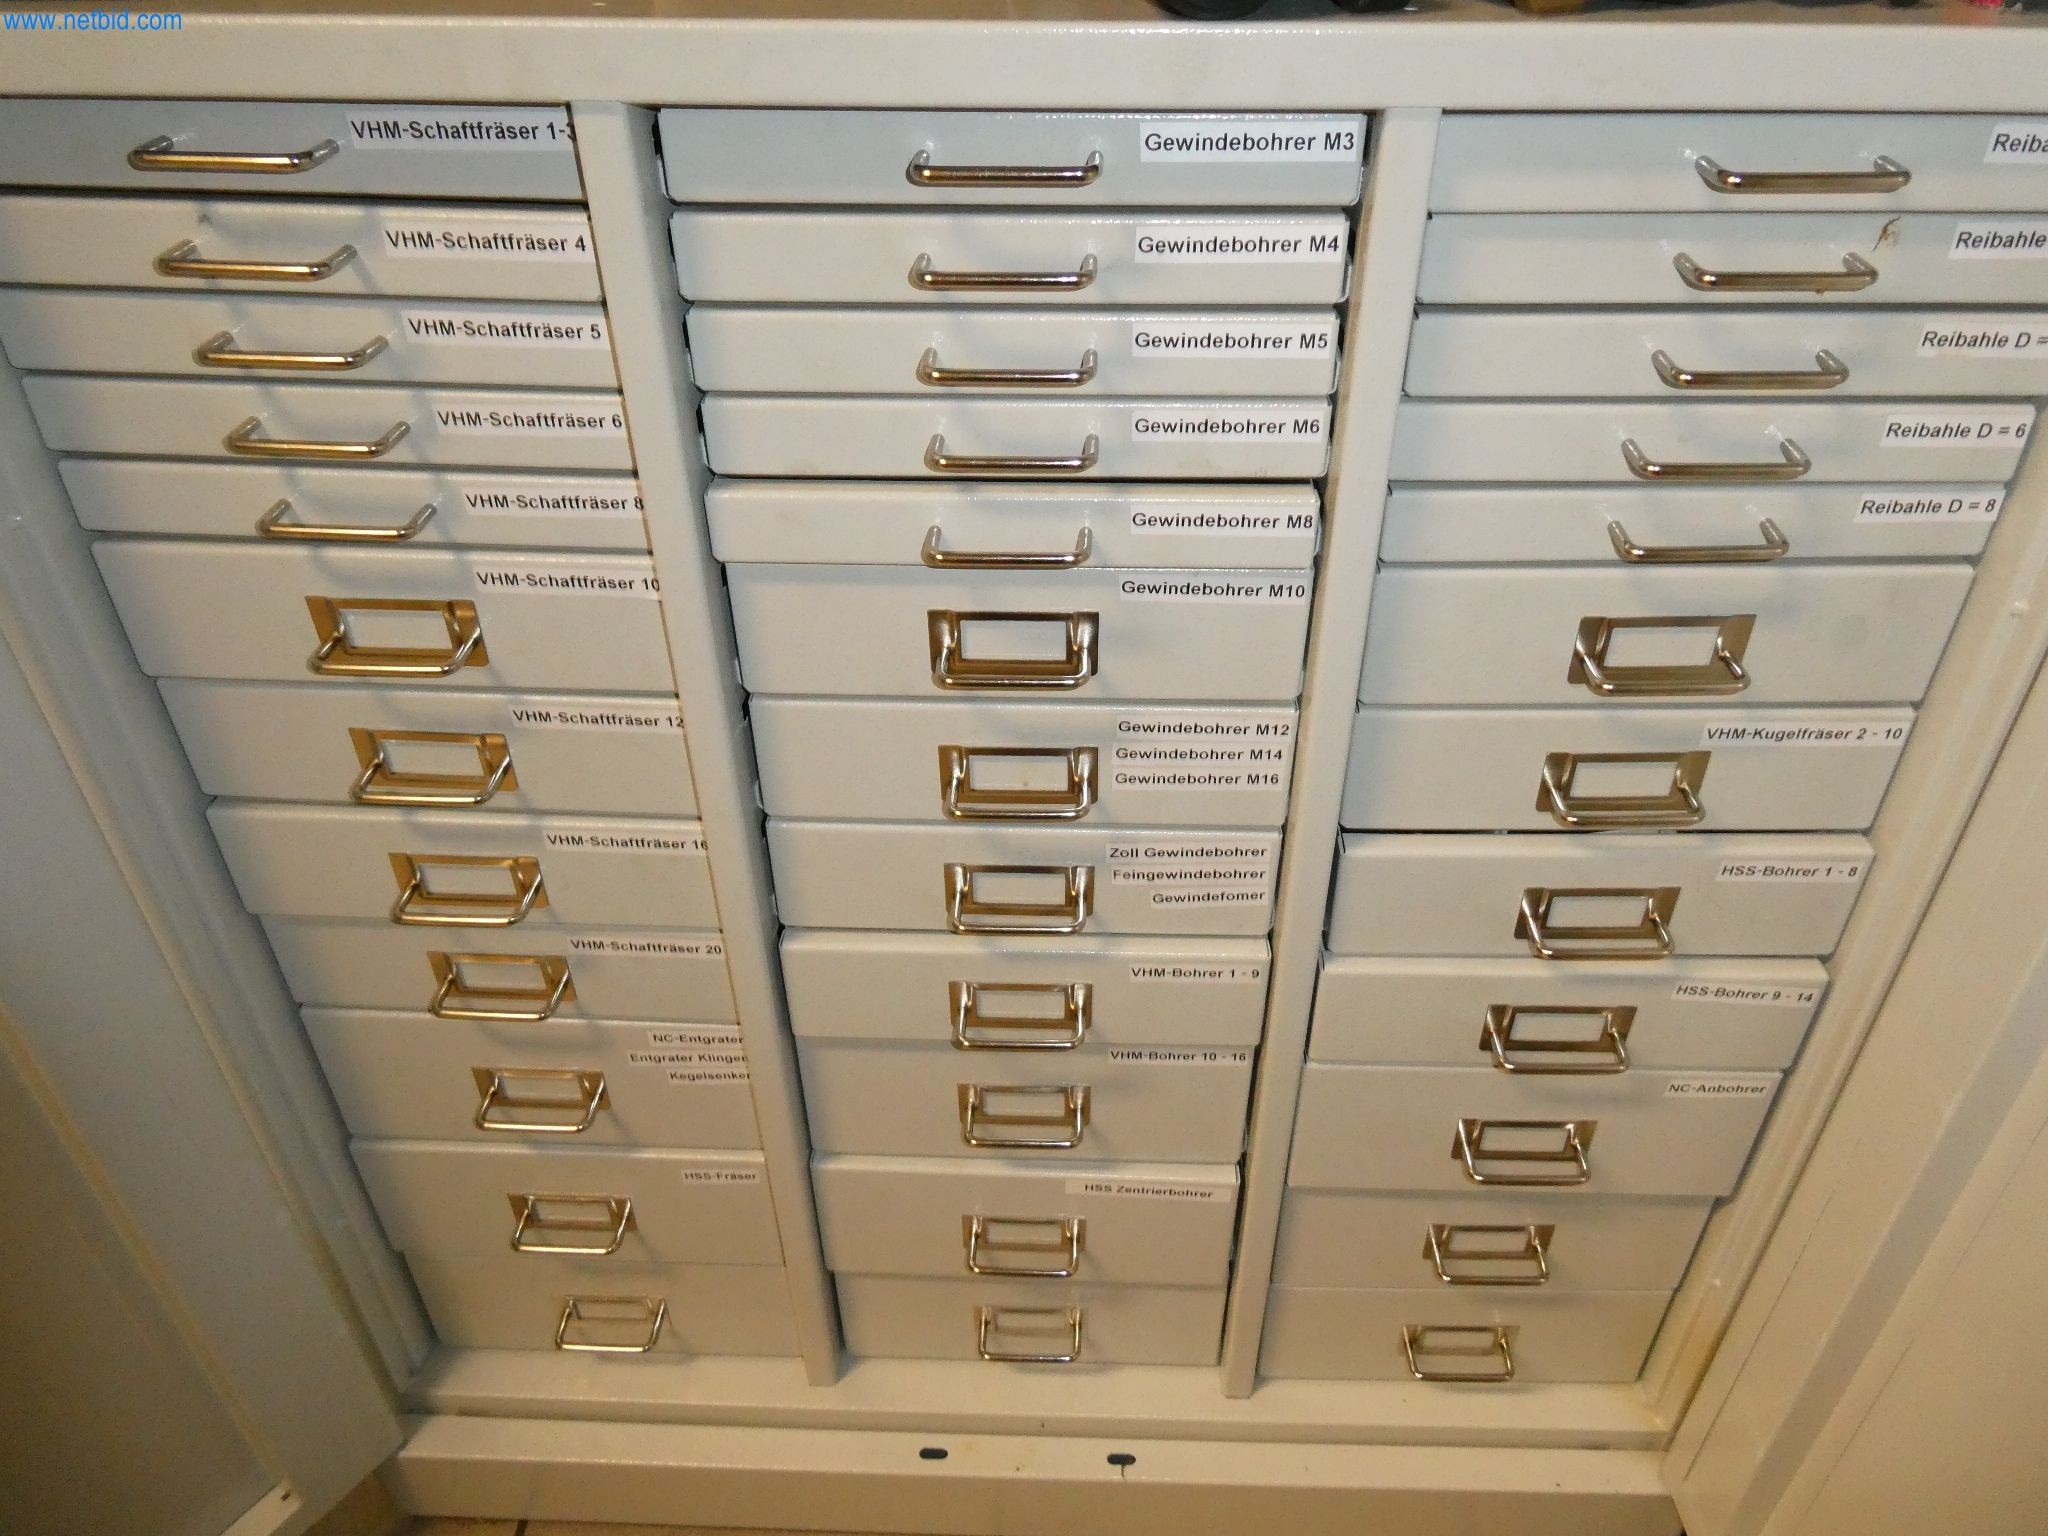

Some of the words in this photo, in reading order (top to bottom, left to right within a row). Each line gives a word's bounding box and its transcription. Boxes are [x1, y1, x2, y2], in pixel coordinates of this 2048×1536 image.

[351, 120, 539, 140] VHM-Schaftfräser
[1145, 133, 1316, 151] Gewindebohrer
[1324, 132, 1355, 151] M3
[386, 230, 568, 251] VHM-Schaftfräser
[575, 235, 586, 251] 4
[1138, 236, 1302, 253] Gewindebohrer
[1309, 235, 1340, 252] M4
[1955, 231, 2047, 249] Reibahle
[408, 318, 584, 339] VHM-Schaftfräser
[591, 323, 601, 339] 5
[1134, 332, 1293, 349] Gewindebohrer
[1299, 333, 1329, 349] M5
[1921, 331, 2009, 348] Reibahle
[2014, 332, 2031, 348] D
[437, 411, 606, 428] VHM-Schaftfräser
[611, 414, 622, 428] 6
[1134, 418, 1287, 434] Gewindebohrer
[1293, 419, 1320, 434] M6
[1885, 422, 1971, 438] Reibahle
[1976, 423, 1993, 438] D
[2015, 423, 2027, 438] 6
[465, 493, 628, 511] VHM-Schaftfräser
[633, 496, 645, 511] 8
[1860, 500, 1942, 514] Reibahle
[1947, 499, 1963, 513] D
[1985, 499, 1997, 513] 8
[1132, 512, 1280, 529] Gewindebohrer
[1286, 514, 1313, 529] M8
[477, 571, 635, 590] VHM-Schaftfräser
[641, 577, 660, 592] 10
[1121, 580, 1263, 597] Gewindebohrer
[1268, 584, 1305, 598] M10
[512, 710, 660, 727] VHM-Schaftfräser
[665, 715, 684, 728] 12
[1118, 720, 1251, 735] Gewindebohrer
[1256, 723, 1290, 736] M12
[1706, 727, 1852, 742] VHM-Kugelfräser
[1856, 728, 1867, 740] 2
[1884, 728, 1903, 739] 10
[1115, 747, 1245, 761] Gewindebohrer
[1249, 749, 1283, 760] M14
[1115, 772, 1242, 785] Gewindebohrer
[1246, 773, 1279, 785] M16
[547, 834, 686, 849] VHM-Schaftfräser
[692, 840, 708, 850] 16
[1109, 848, 1139, 858] Zoll
[1144, 848, 1268, 858] Gewindebohrer
[1113, 869, 1267, 882] Feingewindebohrer
[1721, 865, 1819, 877] HSS-Bohrer
[1825, 866, 1832, 876] 1
[1847, 866, 1859, 876] 8
[1152, 890, 1266, 904] Gewindefomer
[571, 939, 700, 955] VHM-Schaftfräser
[705, 945, 722, 954] 20
[1131, 967, 1224, 978] VHM-Bohrer
[1229, 969, 1236, 978] 1
[1251, 969, 1260, 979] 9
[1676, 985, 1768, 1000] HSS-Bohrer
[1771, 990, 1781, 1001] 9
[1797, 993, 1814, 1001] 14
[1110, 1051, 1197, 1061] VHM-Bohrer
[1201, 1052, 1217, 1061] 10
[1668, 1083, 1766, 1094] NC-Anbohrer
[1084, 1183, 1112, 1192] HSS
[1116, 1184, 1213, 1199] Zentrierbohrer
